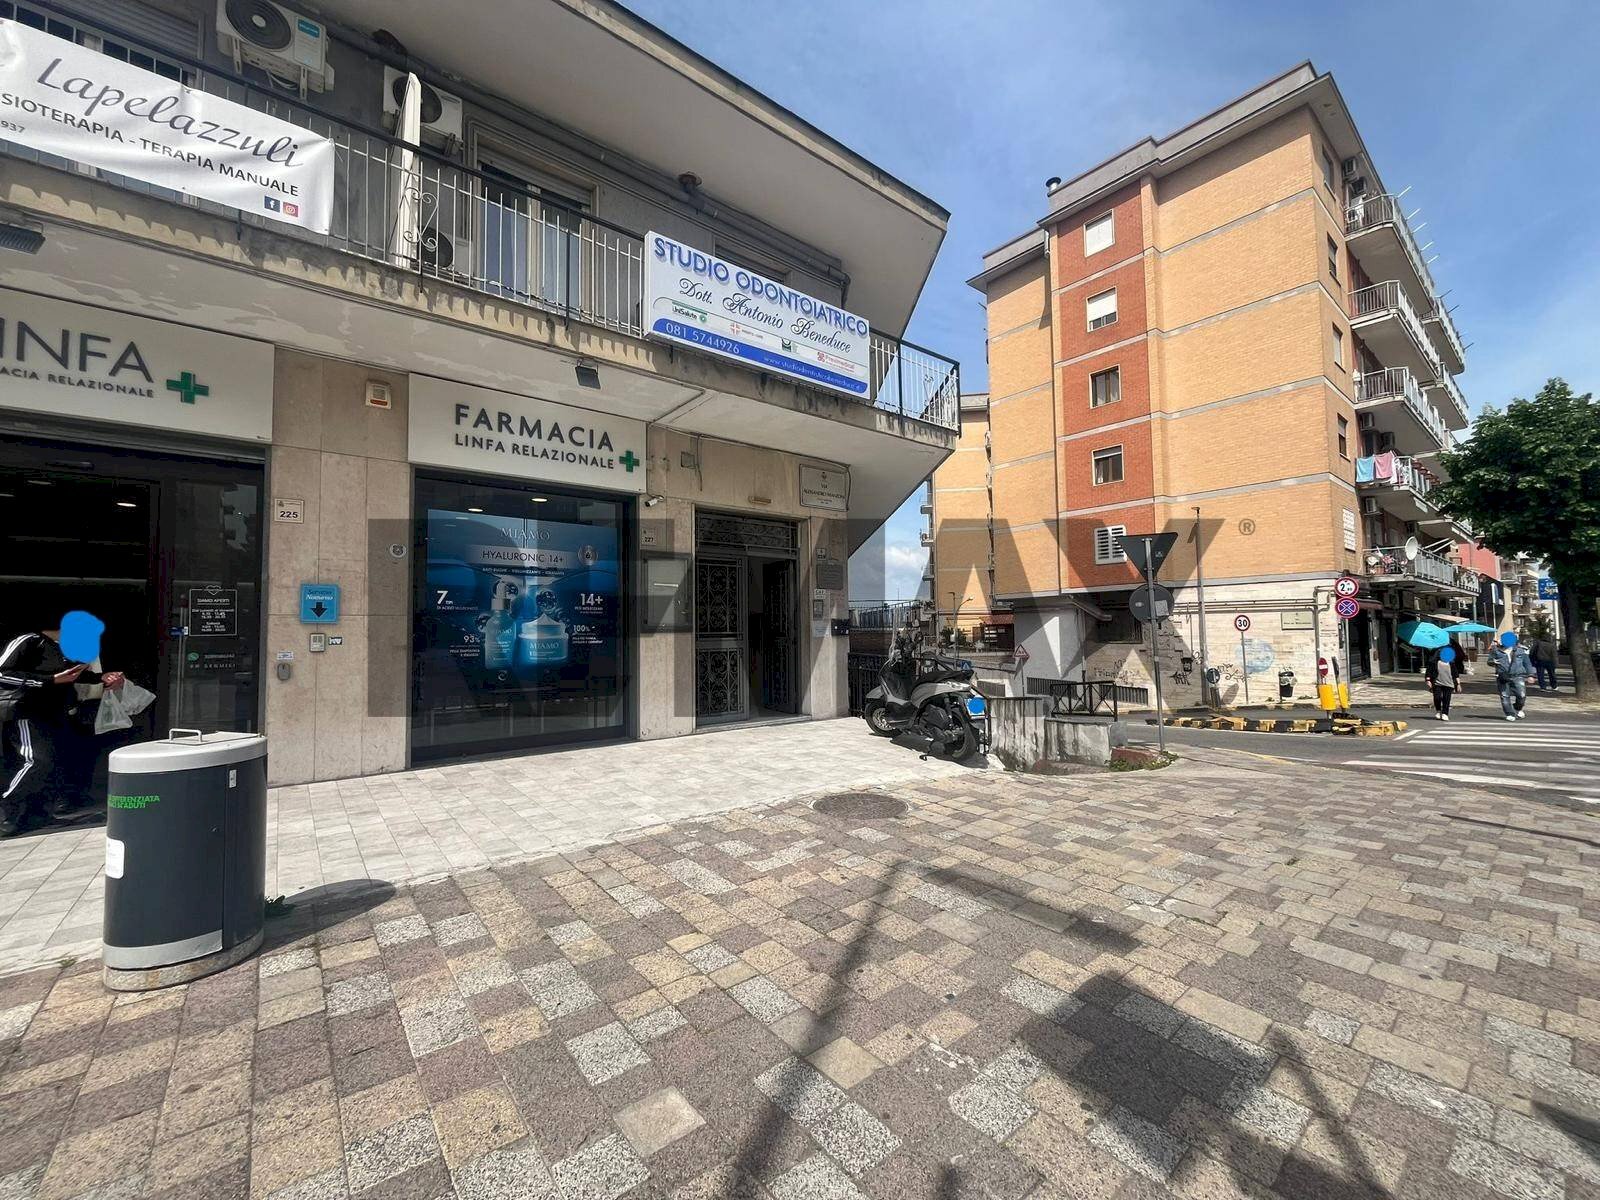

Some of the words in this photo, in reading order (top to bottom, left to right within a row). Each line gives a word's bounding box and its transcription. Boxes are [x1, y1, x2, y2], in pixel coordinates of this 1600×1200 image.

[37, 58, 304, 167] Lapelazzuli
[140, 138, 214, 172] TERAPIA
[219, 163, 299, 197] MANUALE
[654, 237, 730, 284] STUDIO
[735, 271, 868, 337] ODONTOIATRICO
[679, 277, 713, 305] Dott.
[722, 292, 784, 329] Antonio
[790, 317, 851, 354] Beneduce
[665, 322, 687, 338] 081
[692, 330, 740, 354] 5744926
[47, 373, 154, 398] RELAZIONALE
[455, 403, 614, 452] FARMACIA
[455, 433, 506, 453] LINFA
[511, 443, 615, 469] RELAZIONALE
[279, 510, 299, 519] 225
[499, 526, 551, 541] MIAMO
[482, 550, 545, 562] HYALURONIC
[549, 554, 565, 563] 14+
[436, 590, 449, 605] 7
[580, 593, 604, 606] 14+
[1237, 618, 1248, 628] 30
